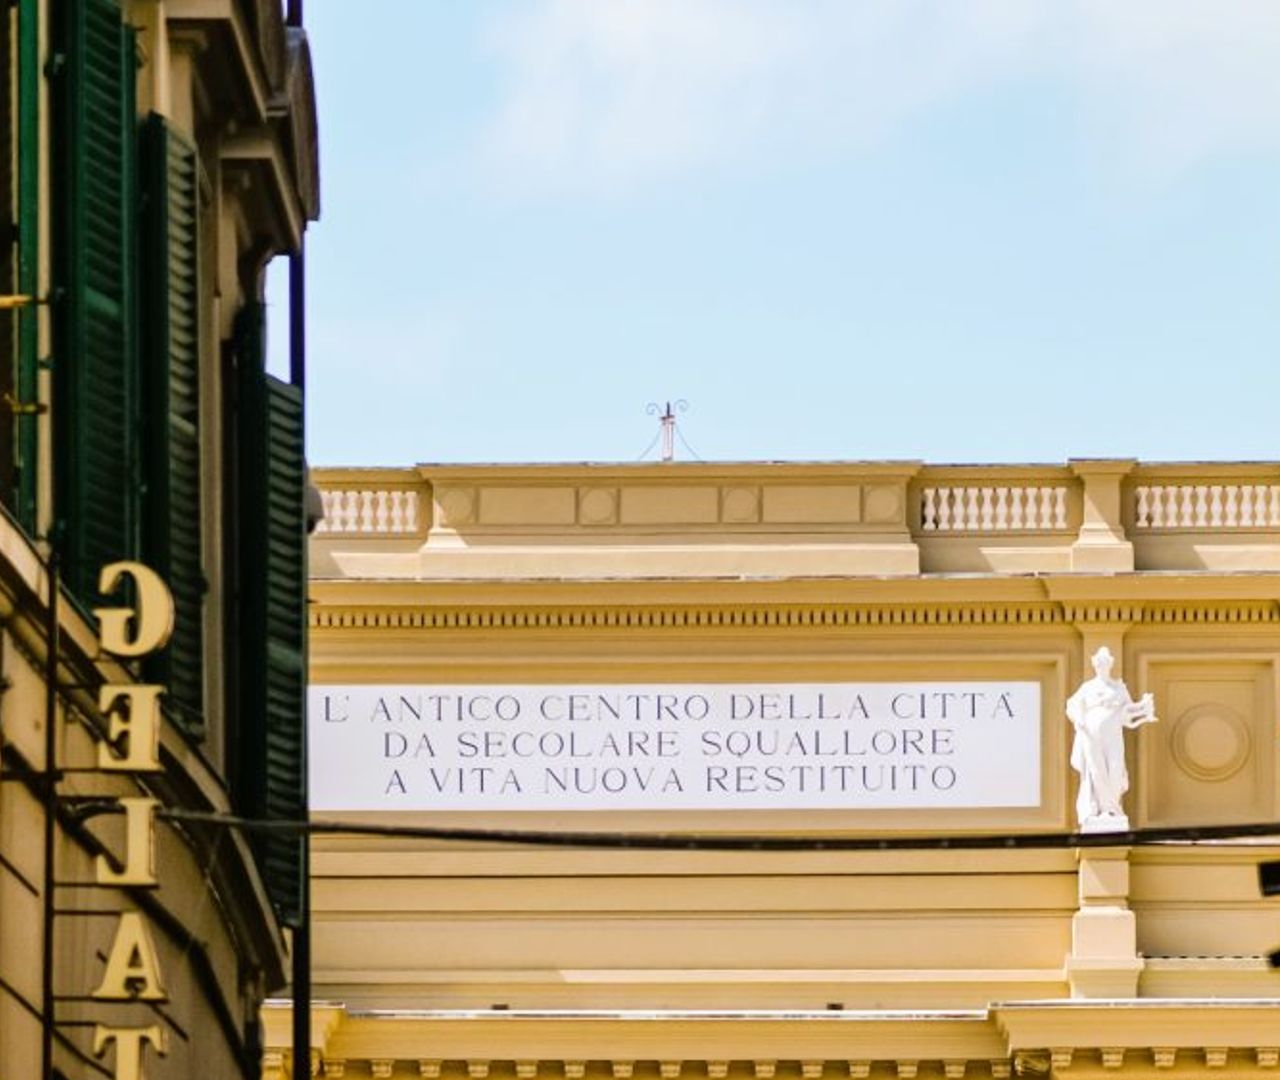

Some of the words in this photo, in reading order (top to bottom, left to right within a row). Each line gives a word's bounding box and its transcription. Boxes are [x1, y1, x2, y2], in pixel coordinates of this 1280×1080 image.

[370, 695, 521, 722] ANTICO
[539, 694, 711, 721] CENTRO
[729, 693, 871, 720] DELLA
[384, 731, 436, 759] DA
[457, 730, 681, 758] SECOLARE
[700, 728, 955, 759] SQUALLORE
[384, 767, 408, 795] A
[428, 767, 523, 794] VITA
[540, 766, 684, 794] NUOVA
[706, 764, 957, 793] RESTITUITO
